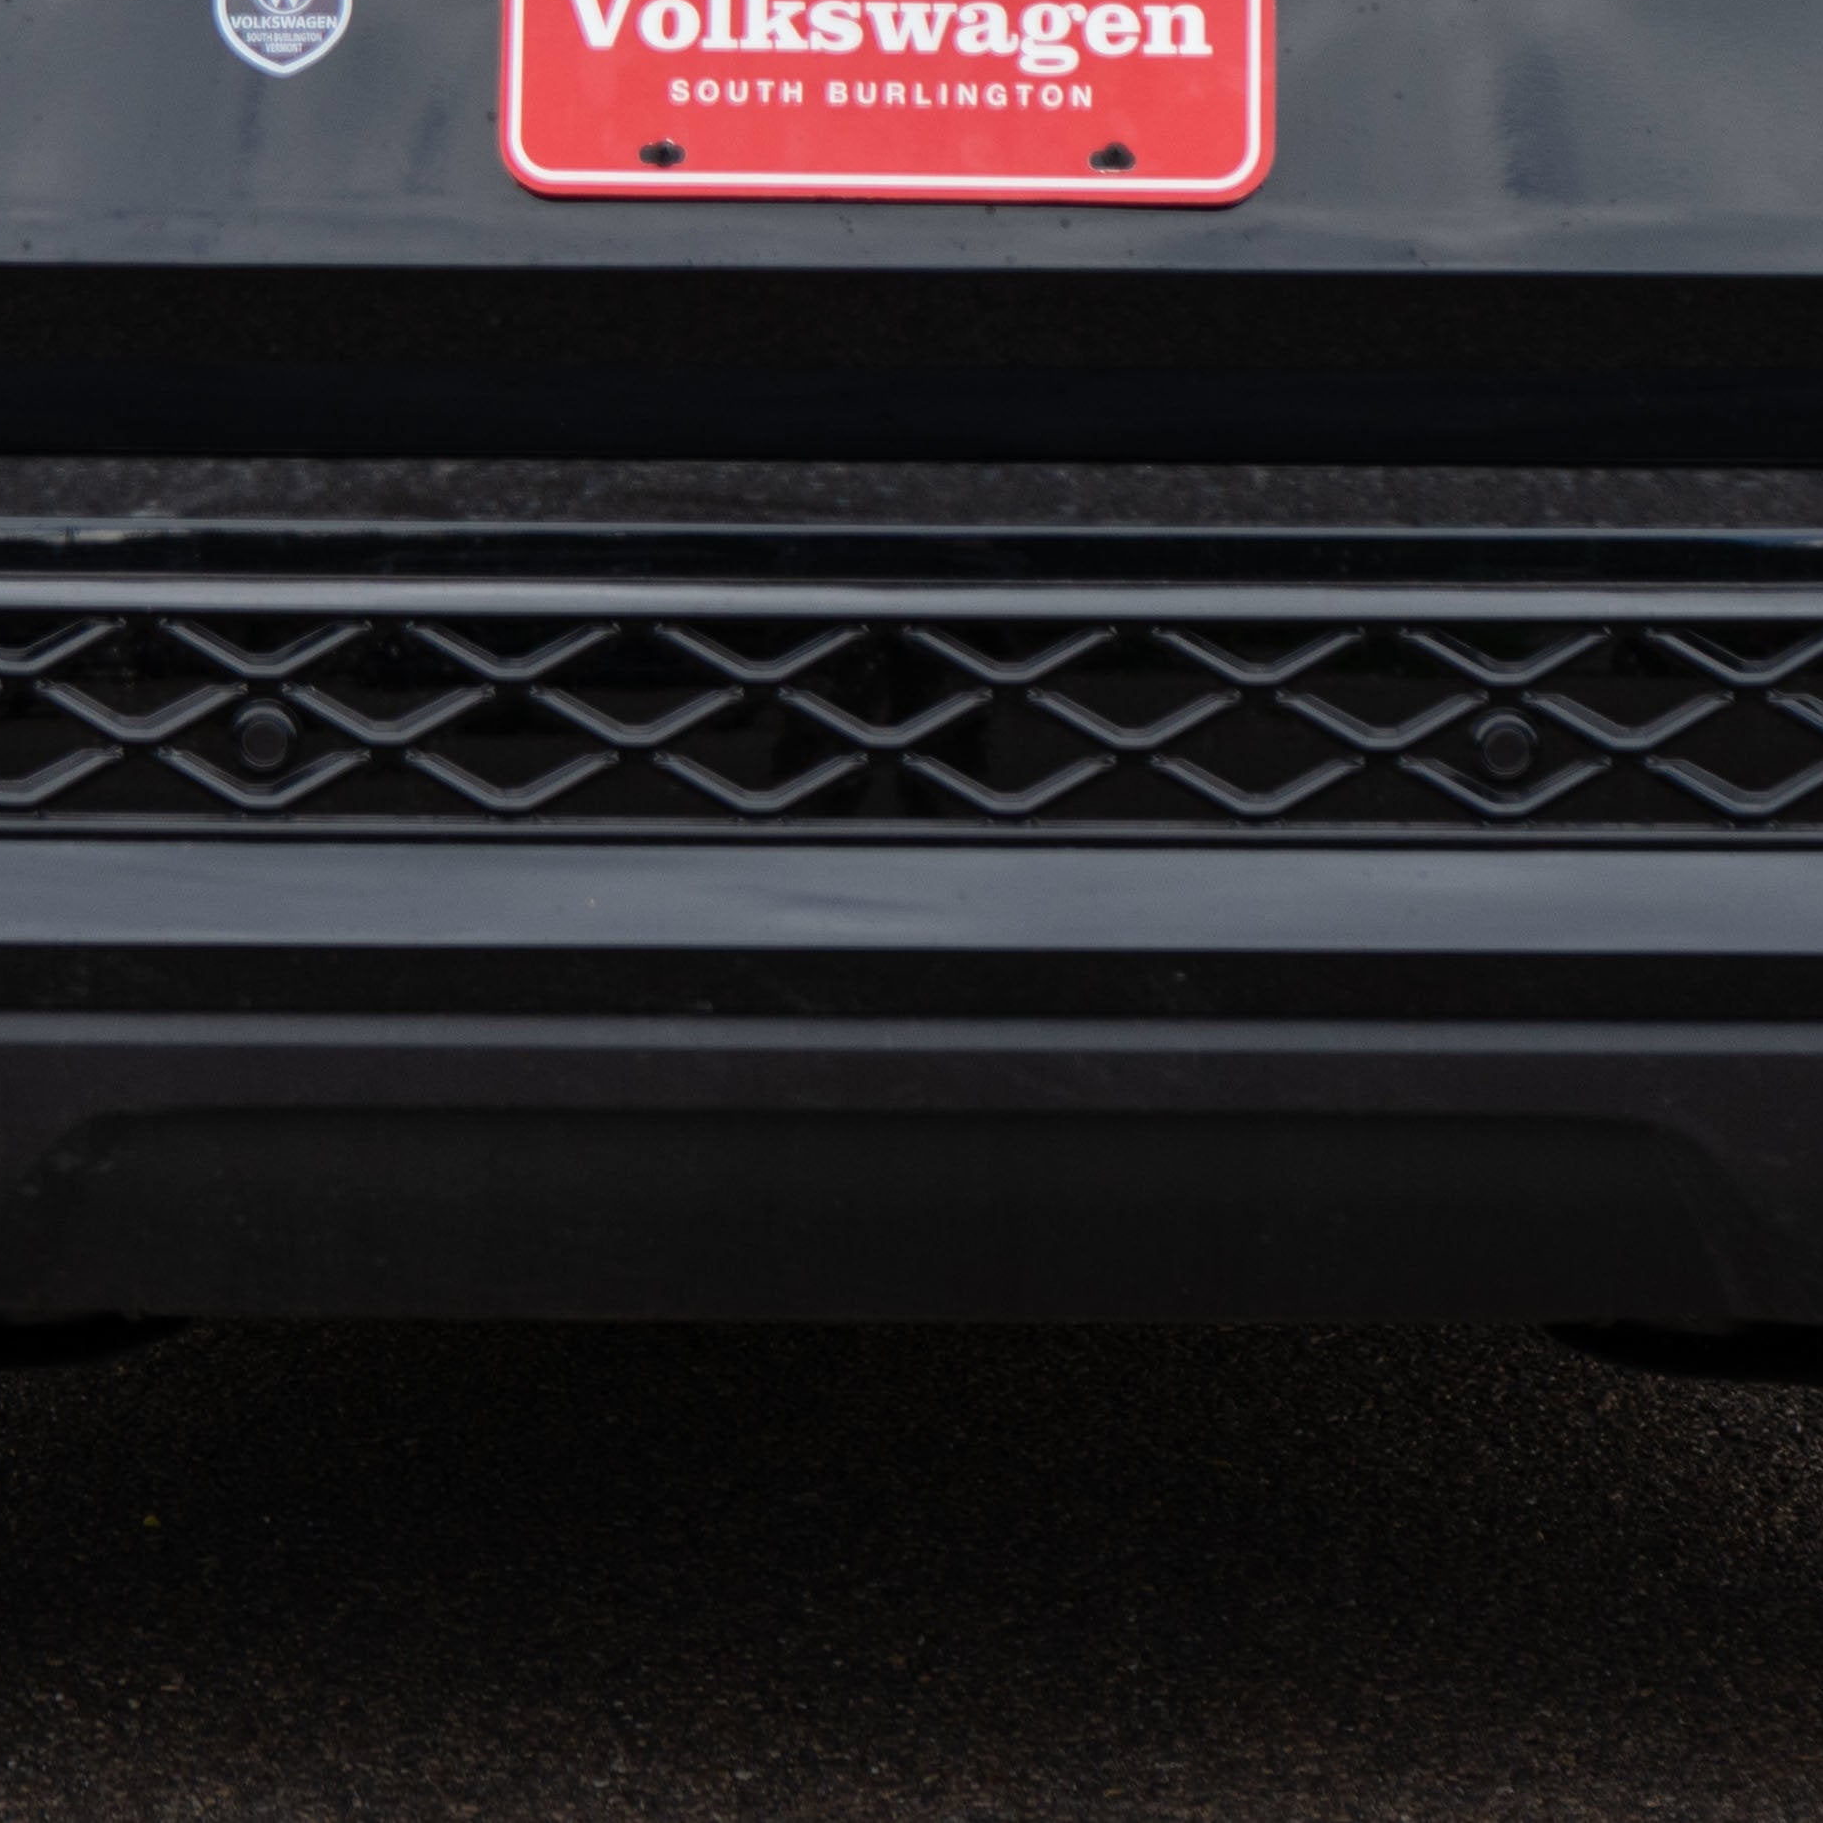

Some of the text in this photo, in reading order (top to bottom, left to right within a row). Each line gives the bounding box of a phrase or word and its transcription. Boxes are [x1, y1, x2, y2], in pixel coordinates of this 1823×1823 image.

[230, 15, 338, 29] VOLKSWAGEN
[668, 78, 1093, 109] SOUTH BURLINGTON
